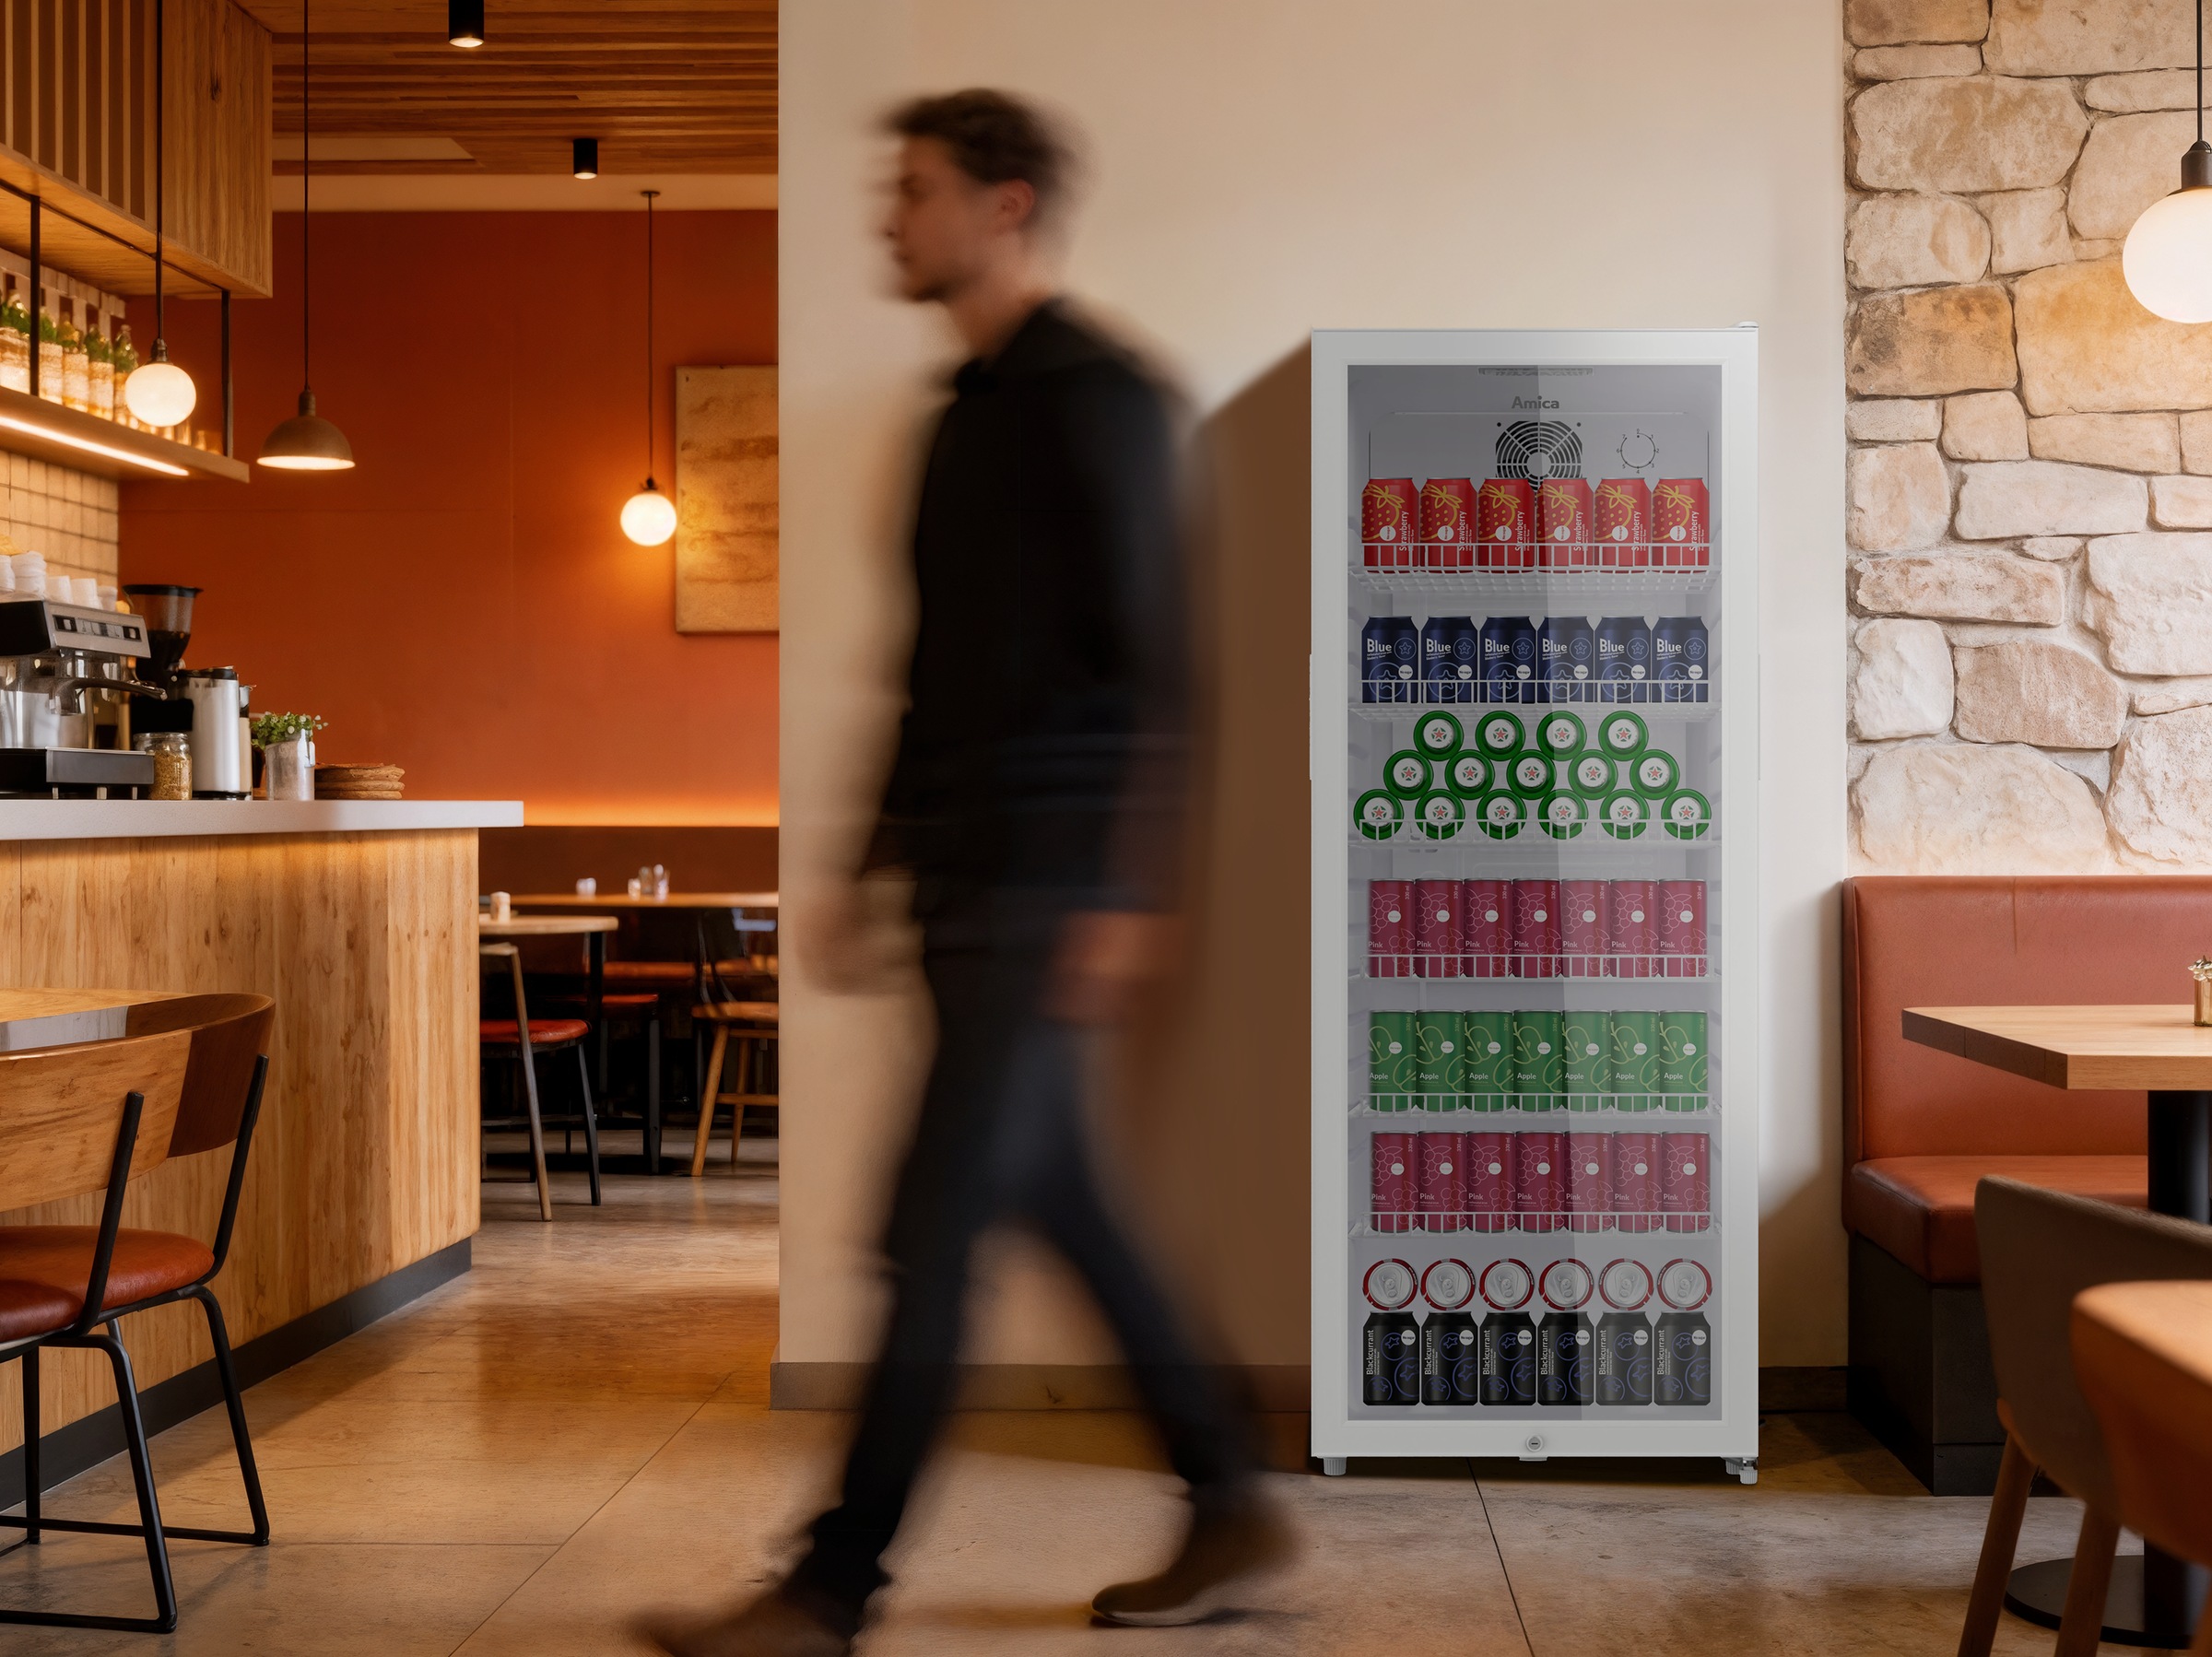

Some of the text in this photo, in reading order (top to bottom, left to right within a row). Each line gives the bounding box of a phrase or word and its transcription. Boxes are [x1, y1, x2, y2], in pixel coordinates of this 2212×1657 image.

[1512, 395, 1559, 409] Amica
[1399, 511, 1409, 551] Srawberry
[1457, 511, 1467, 551] Srawberry
[1514, 511, 1524, 551] Srawberry
[1573, 511, 1583, 551] Srawberry
[1631, 511, 1641, 551] Srawberry
[1689, 511, 1699, 551] Srawberry
[1367, 638, 1393, 652] Blue
[1426, 638, 1452, 652] Blue
[1485, 638, 1511, 652] Blue
[1542, 638, 1568, 652] Blue
[1599, 638, 1625, 652] Blue
[1657, 638, 1682, 652] Blue
[1369, 940, 1383, 948] Pink
[1417, 940, 1431, 948] Pink
[1465, 940, 1480, 948] Pink
[1514, 940, 1529, 948] Pink
[1563, 940, 1578, 948] Pink
[1611, 940, 1626, 948] Pink
[1660, 940, 1675, 948] Pink
